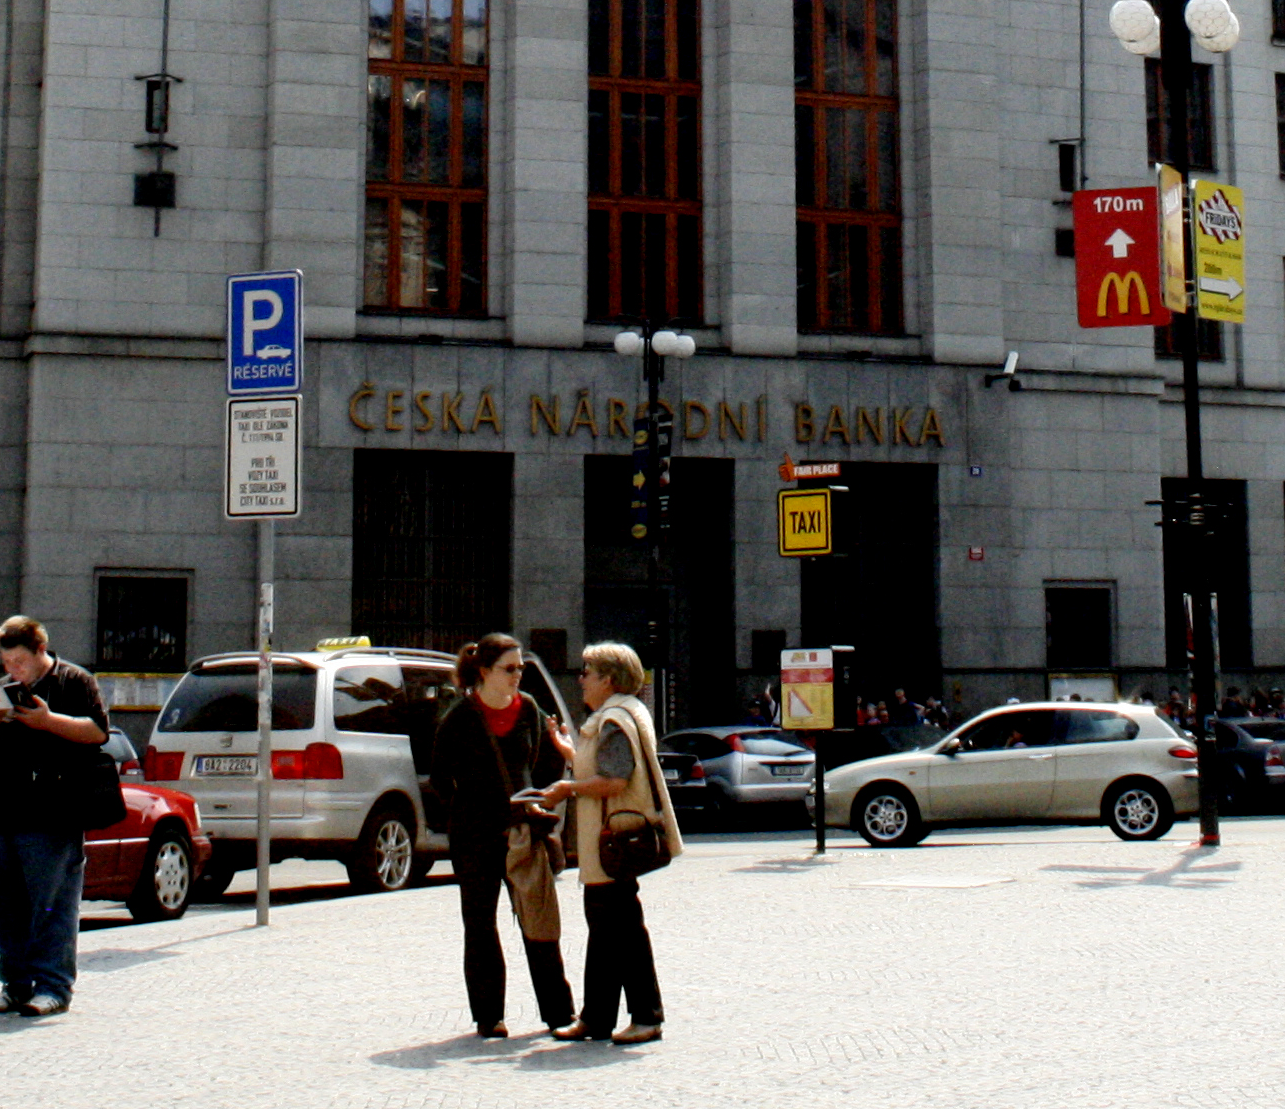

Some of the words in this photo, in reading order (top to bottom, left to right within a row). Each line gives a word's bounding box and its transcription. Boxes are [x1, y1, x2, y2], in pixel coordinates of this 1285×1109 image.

[243, 289, 284, 356] P
[234, 361, 294, 380] RÉSERVÉ
[349, 381, 503, 433] ČESKÁ
[795, 402, 944, 447] BANKA
[794, 465, 812, 477] FAIR
[813, 464, 838, 476] PLACE
[789, 510, 821, 534] TAXI
